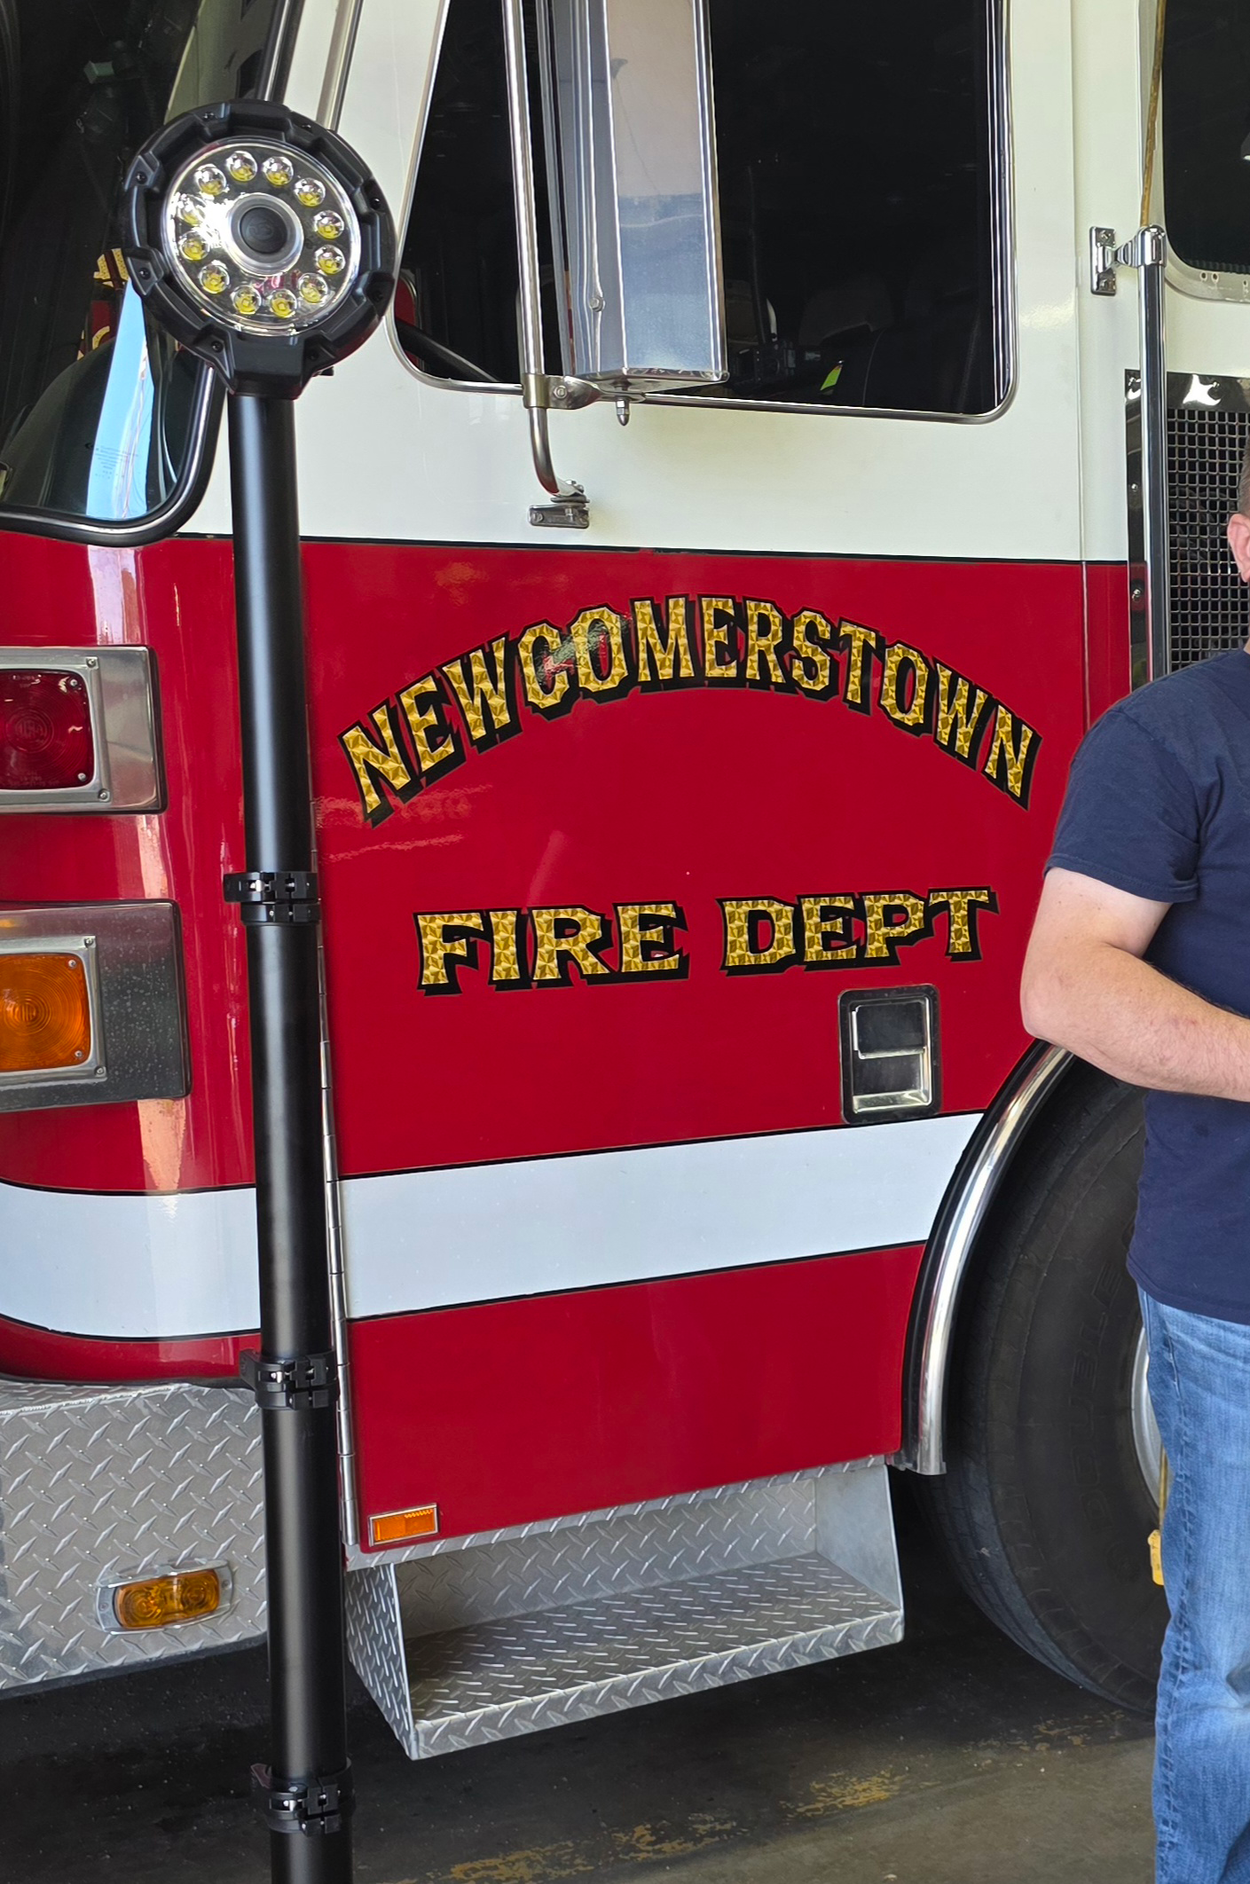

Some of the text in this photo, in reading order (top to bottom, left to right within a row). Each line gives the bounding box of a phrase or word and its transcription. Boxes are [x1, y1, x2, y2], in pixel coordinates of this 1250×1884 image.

[338, 593, 1042, 828] NEWCOMERSTOWN
[413, 886, 998, 995] FIRE DEPT
